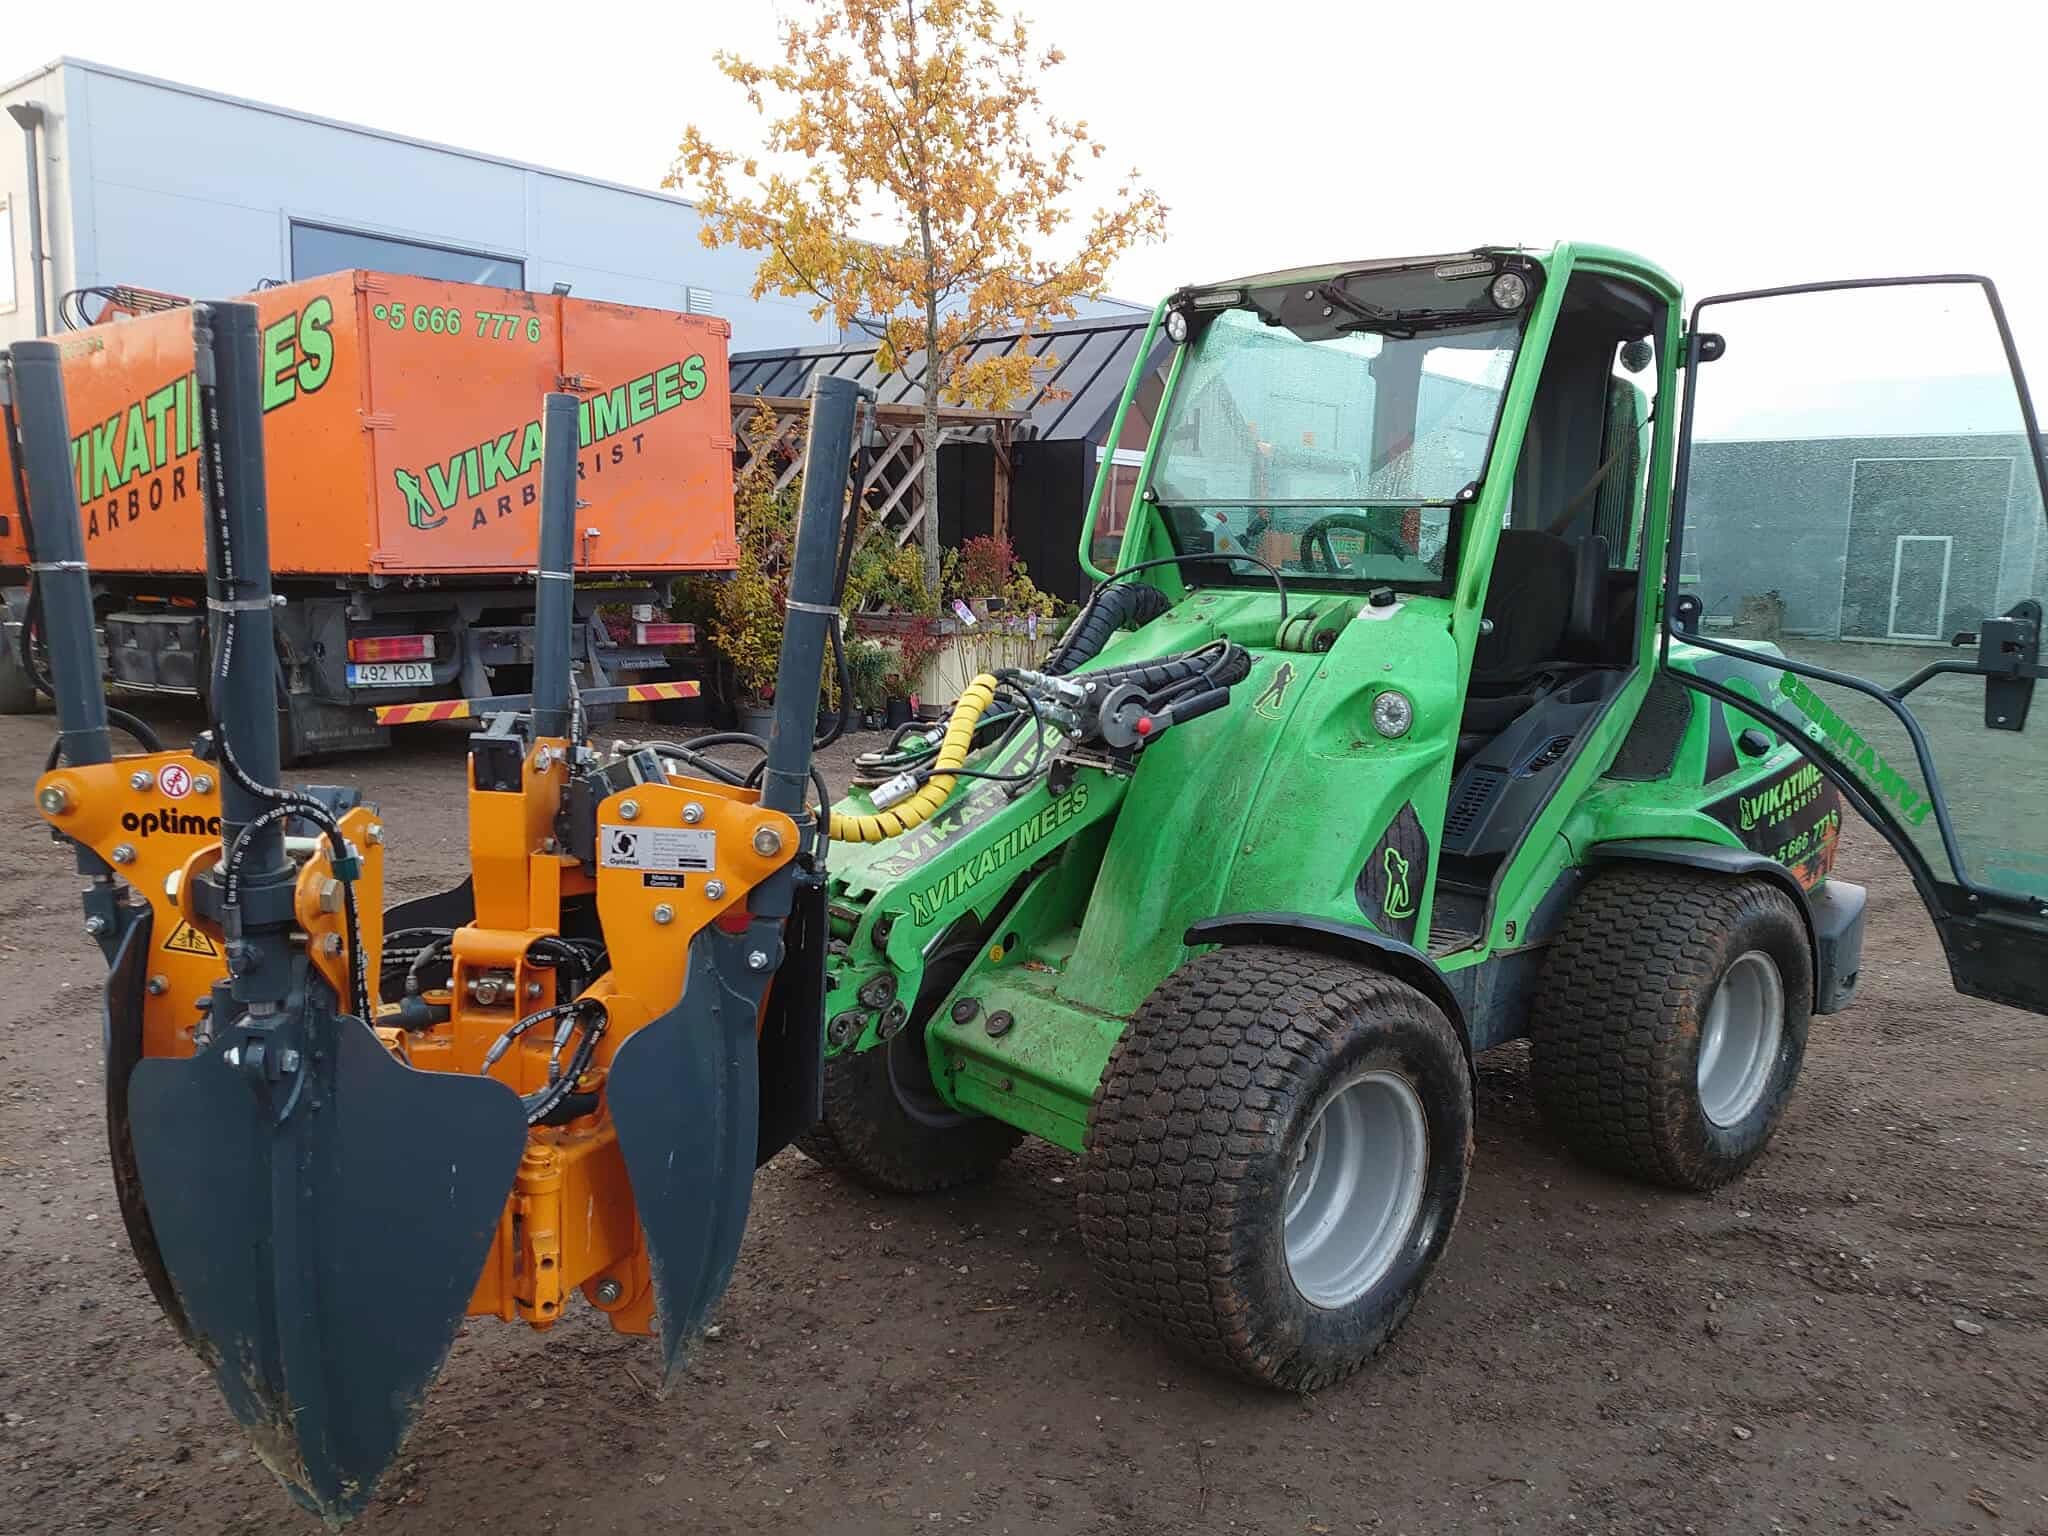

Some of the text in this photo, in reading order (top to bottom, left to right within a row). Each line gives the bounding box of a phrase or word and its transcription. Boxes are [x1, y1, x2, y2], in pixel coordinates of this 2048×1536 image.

[70, 296, 334, 507] IKATIES
[424, 353, 707, 510] VIKAIMEES
[87, 456, 201, 541] ARBORI
[471, 433, 645, 531] ARBRIST
[361, 665, 428, 681] 492 KDX
[121, 807, 222, 838] optima
[1751, 763, 1824, 820] VIKATIME
[925, 783, 1088, 914] VIKATIMEES
